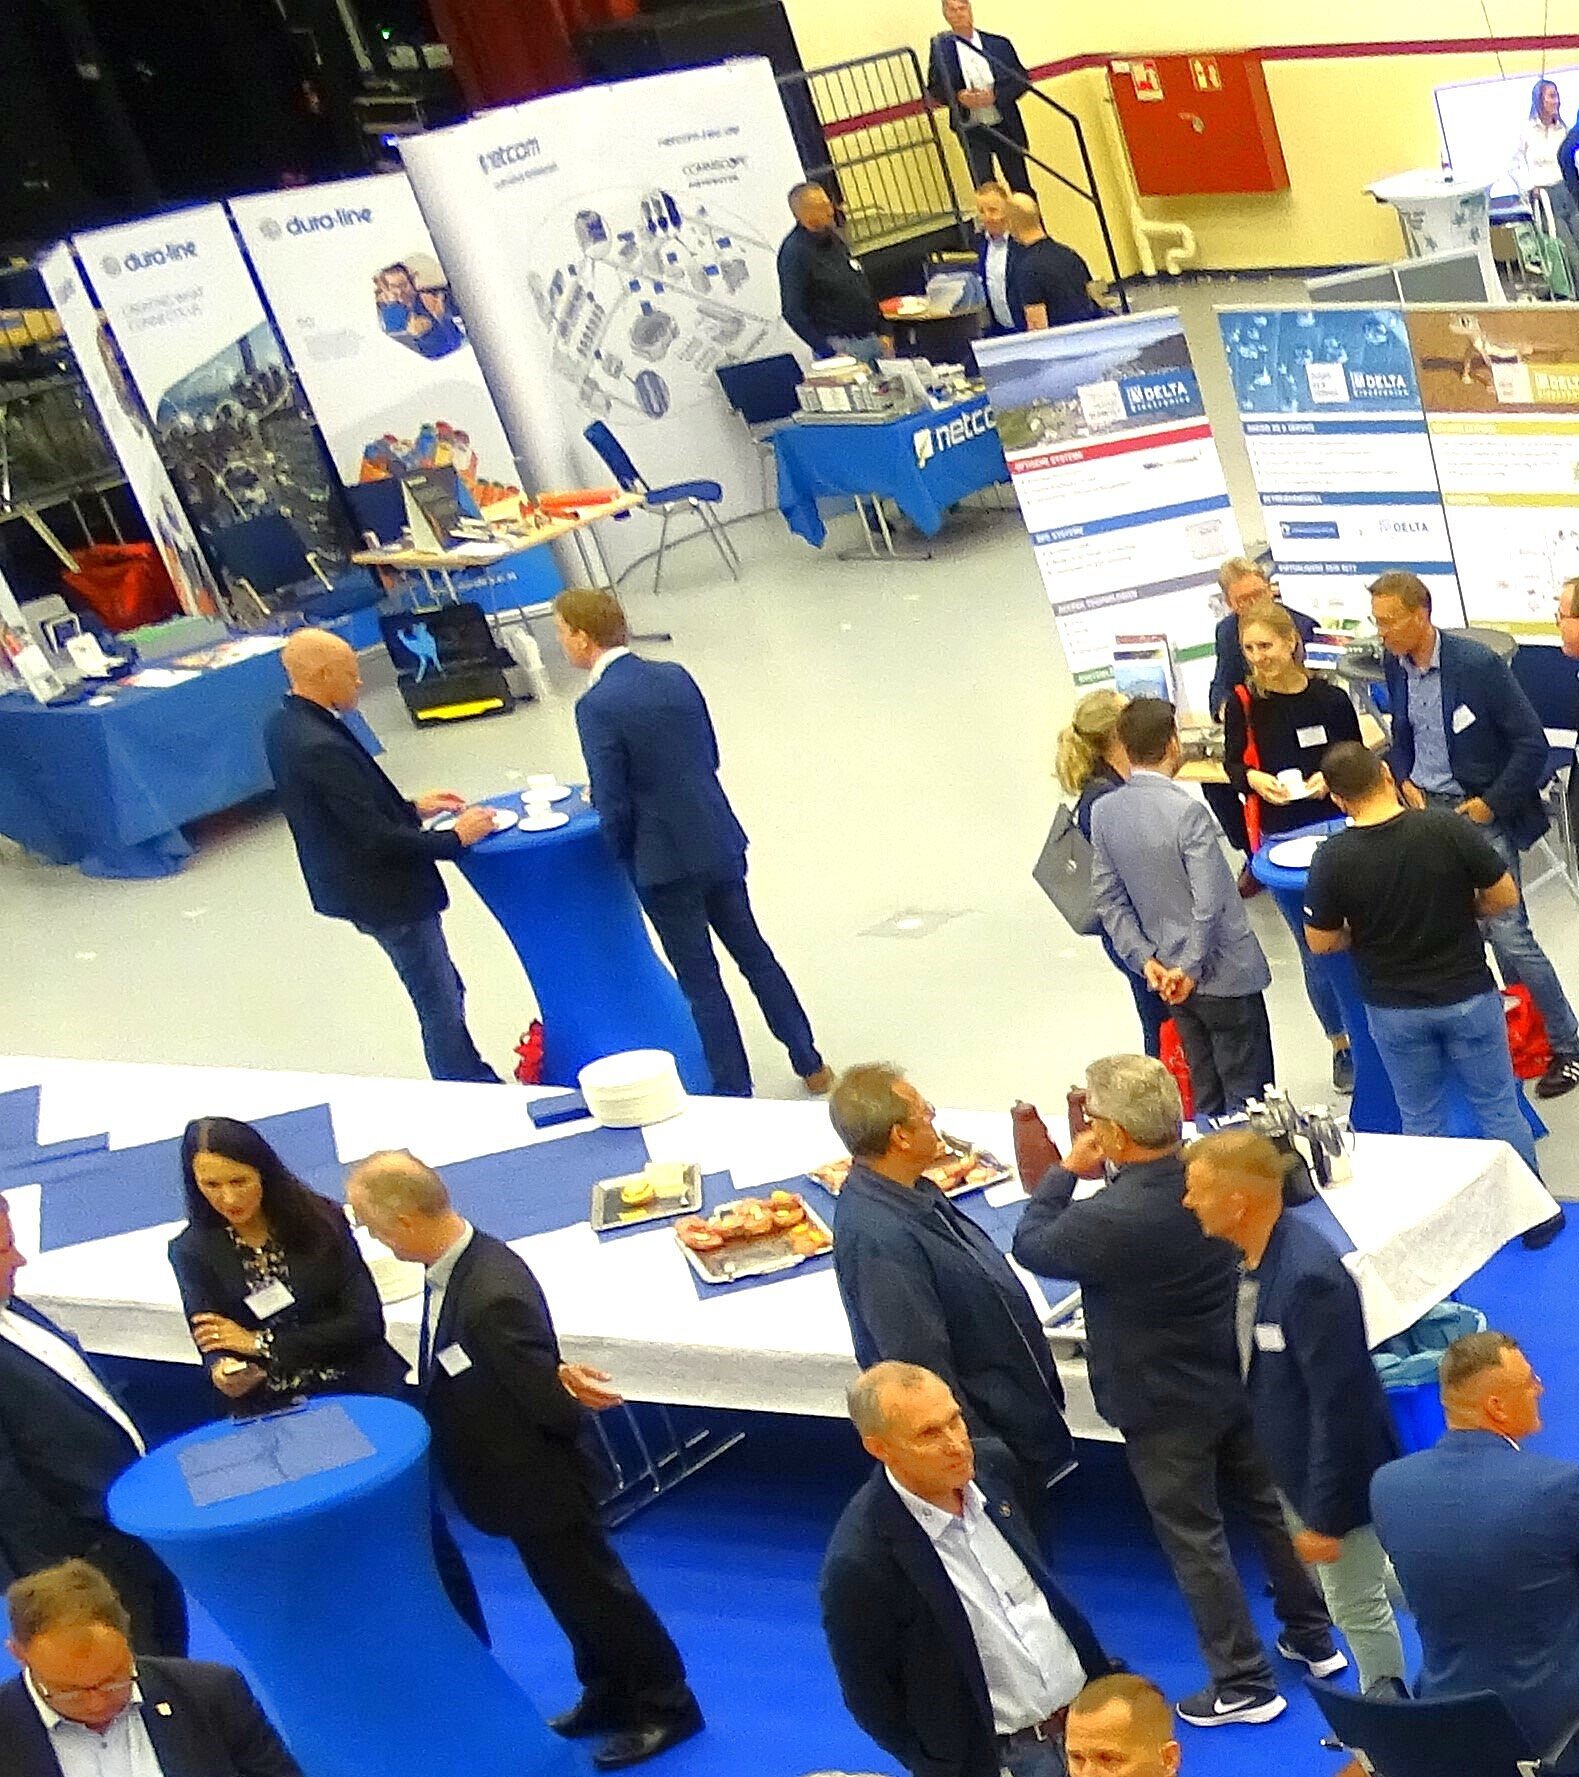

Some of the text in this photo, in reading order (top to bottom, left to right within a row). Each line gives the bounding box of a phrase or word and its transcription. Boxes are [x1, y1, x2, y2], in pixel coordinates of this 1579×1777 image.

[1364, 374, 1407, 389] DELTA
[1145, 381, 1188, 401] DELTA
[933, 407, 997, 451] netco
[1393, 521, 1429, 533] DELTA
